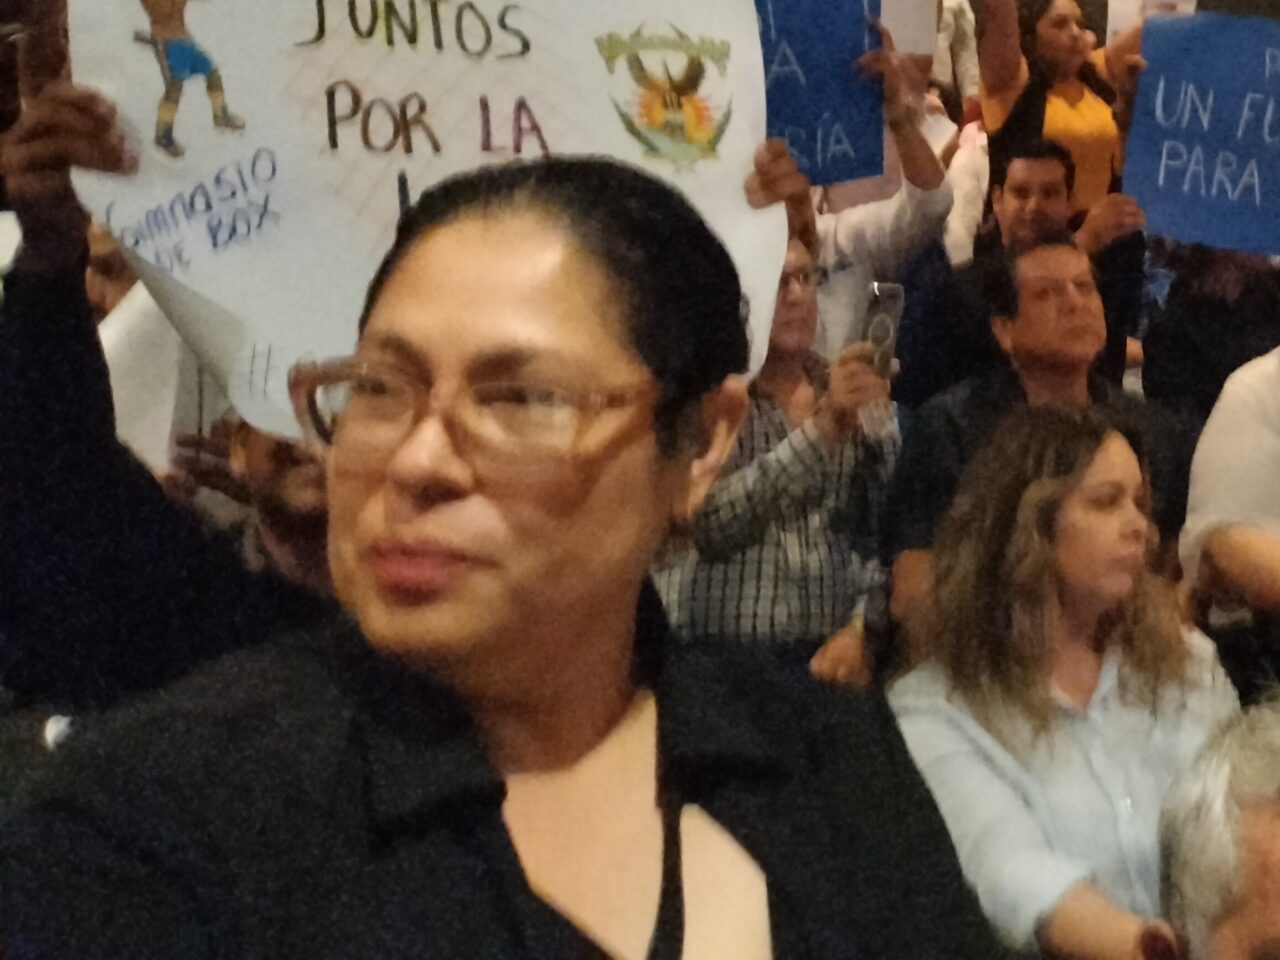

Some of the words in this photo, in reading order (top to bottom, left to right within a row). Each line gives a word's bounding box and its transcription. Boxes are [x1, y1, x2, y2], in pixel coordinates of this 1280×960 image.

[323, 78, 442, 155] POR
[478, 94, 553, 160] LA
[1154, 74, 1215, 133] UN
[1158, 140, 1261, 209] PARA
